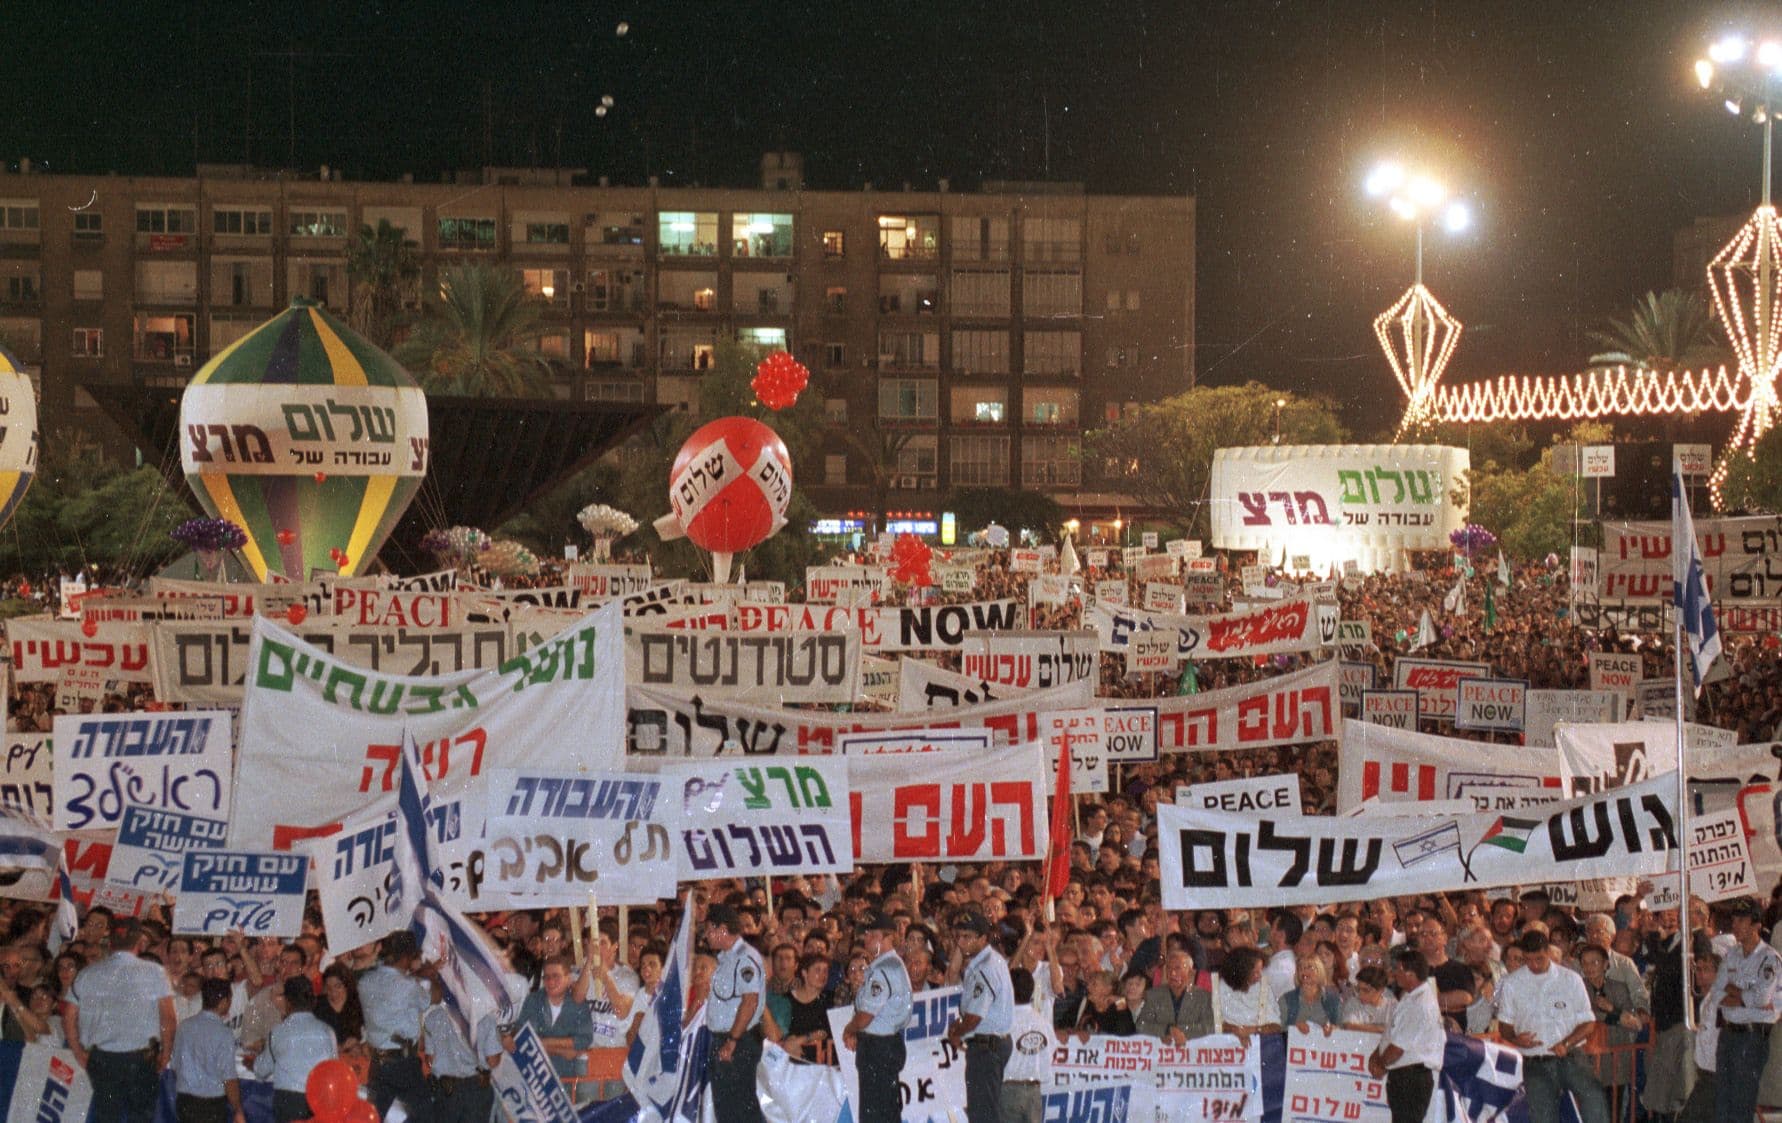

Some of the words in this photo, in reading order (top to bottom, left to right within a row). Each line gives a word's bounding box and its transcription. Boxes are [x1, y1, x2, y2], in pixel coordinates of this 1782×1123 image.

[282, 399, 396, 443] שלום
[188, 424, 276, 464] מרצ
[291, 449, 323, 464] של
[334, 451, 392, 465] עבודה
[680, 453, 724, 506] שלום
[1338, 465, 1443, 505] שלום
[1238, 491, 1335, 526] מרצ
[1342, 511, 1370, 526] של
[1377, 514, 1434, 526] עבודה
[900, 602, 1018, 646] NOW
[13, 639, 149, 671] עכשיו
[1136, 638, 1170, 654] שלום
[640, 632, 847, 687] סטודנטים
[966, 654, 1032, 689] עכשיו
[1039, 635, 1093, 687] שלום
[1136, 656, 1169, 667] עכשיו
[1596, 658, 1638, 672] PEACE
[1602, 674, 1633, 686] NOW
[1365, 696, 1415, 713] PEACE
[1464, 684, 1522, 704] PEACE
[1053, 716, 1096, 729] העם
[1104, 716, 1152, 733] EACE
[1237, 686, 1334, 742] העם
[1371, 712, 1408, 728] NOW
[1472, 703, 1514, 721] NOW
[627, 694, 787, 757] שלום
[734, 766, 833, 813] מרצ
[1203, 788, 1291, 813] PEACE
[130, 810, 182, 834] חזק
[190, 819, 228, 841] עם
[893, 781, 1037, 859] העם
[1547, 793, 1679, 862] גוש
[1694, 819, 1737, 844] לפרק
[682, 823, 836, 871] השלום
[1179, 820, 1383, 888] שלום
[193, 854, 247, 880] חזק
[257, 857, 299, 876] עם
[208, 874, 279, 893] עושה
[1075, 1048, 1099, 1065] את
[1196, 1047, 1247, 1065] לפצות
[1290, 1093, 1362, 1121] שלום
